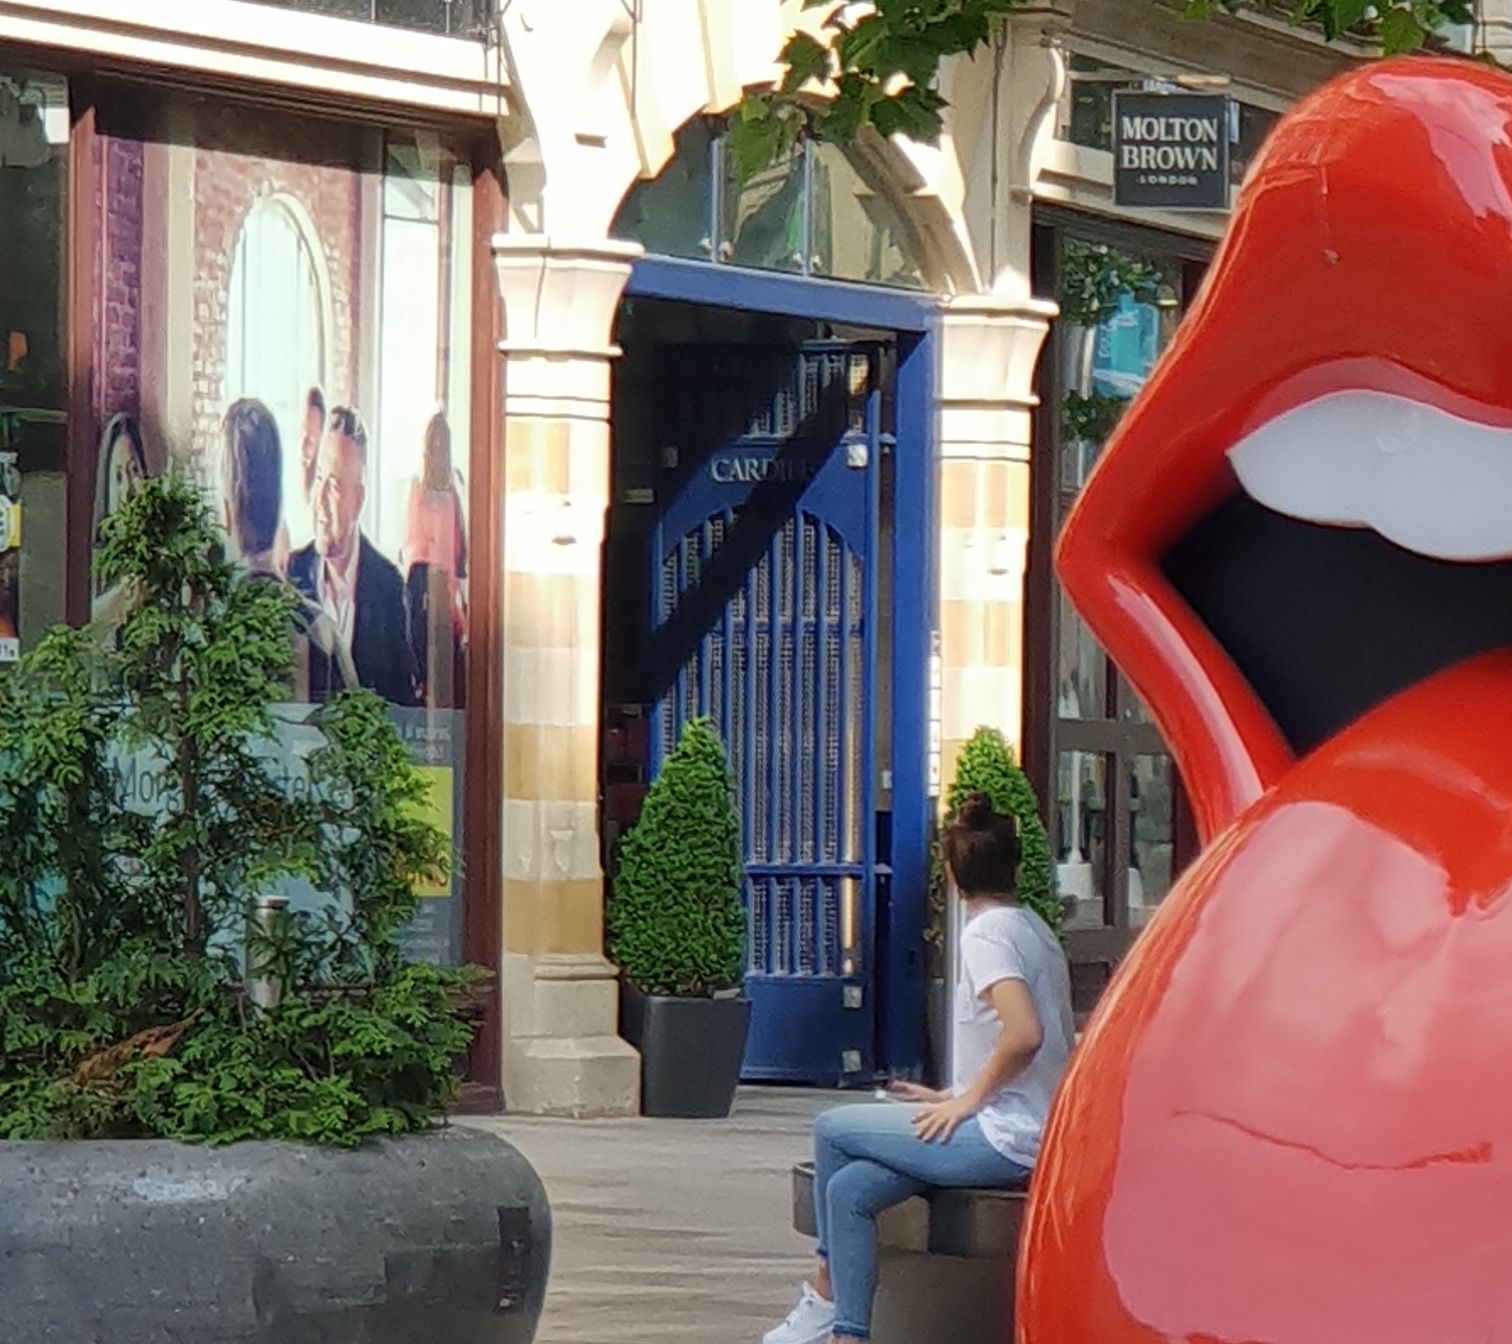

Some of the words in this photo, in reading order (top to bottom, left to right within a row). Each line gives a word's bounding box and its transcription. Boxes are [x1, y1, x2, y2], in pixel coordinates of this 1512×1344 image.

[1121, 116, 1218, 143] MOLTON
[1121, 145, 1218, 171] BROWN
[1139, 174, 1199, 186] LONDON
